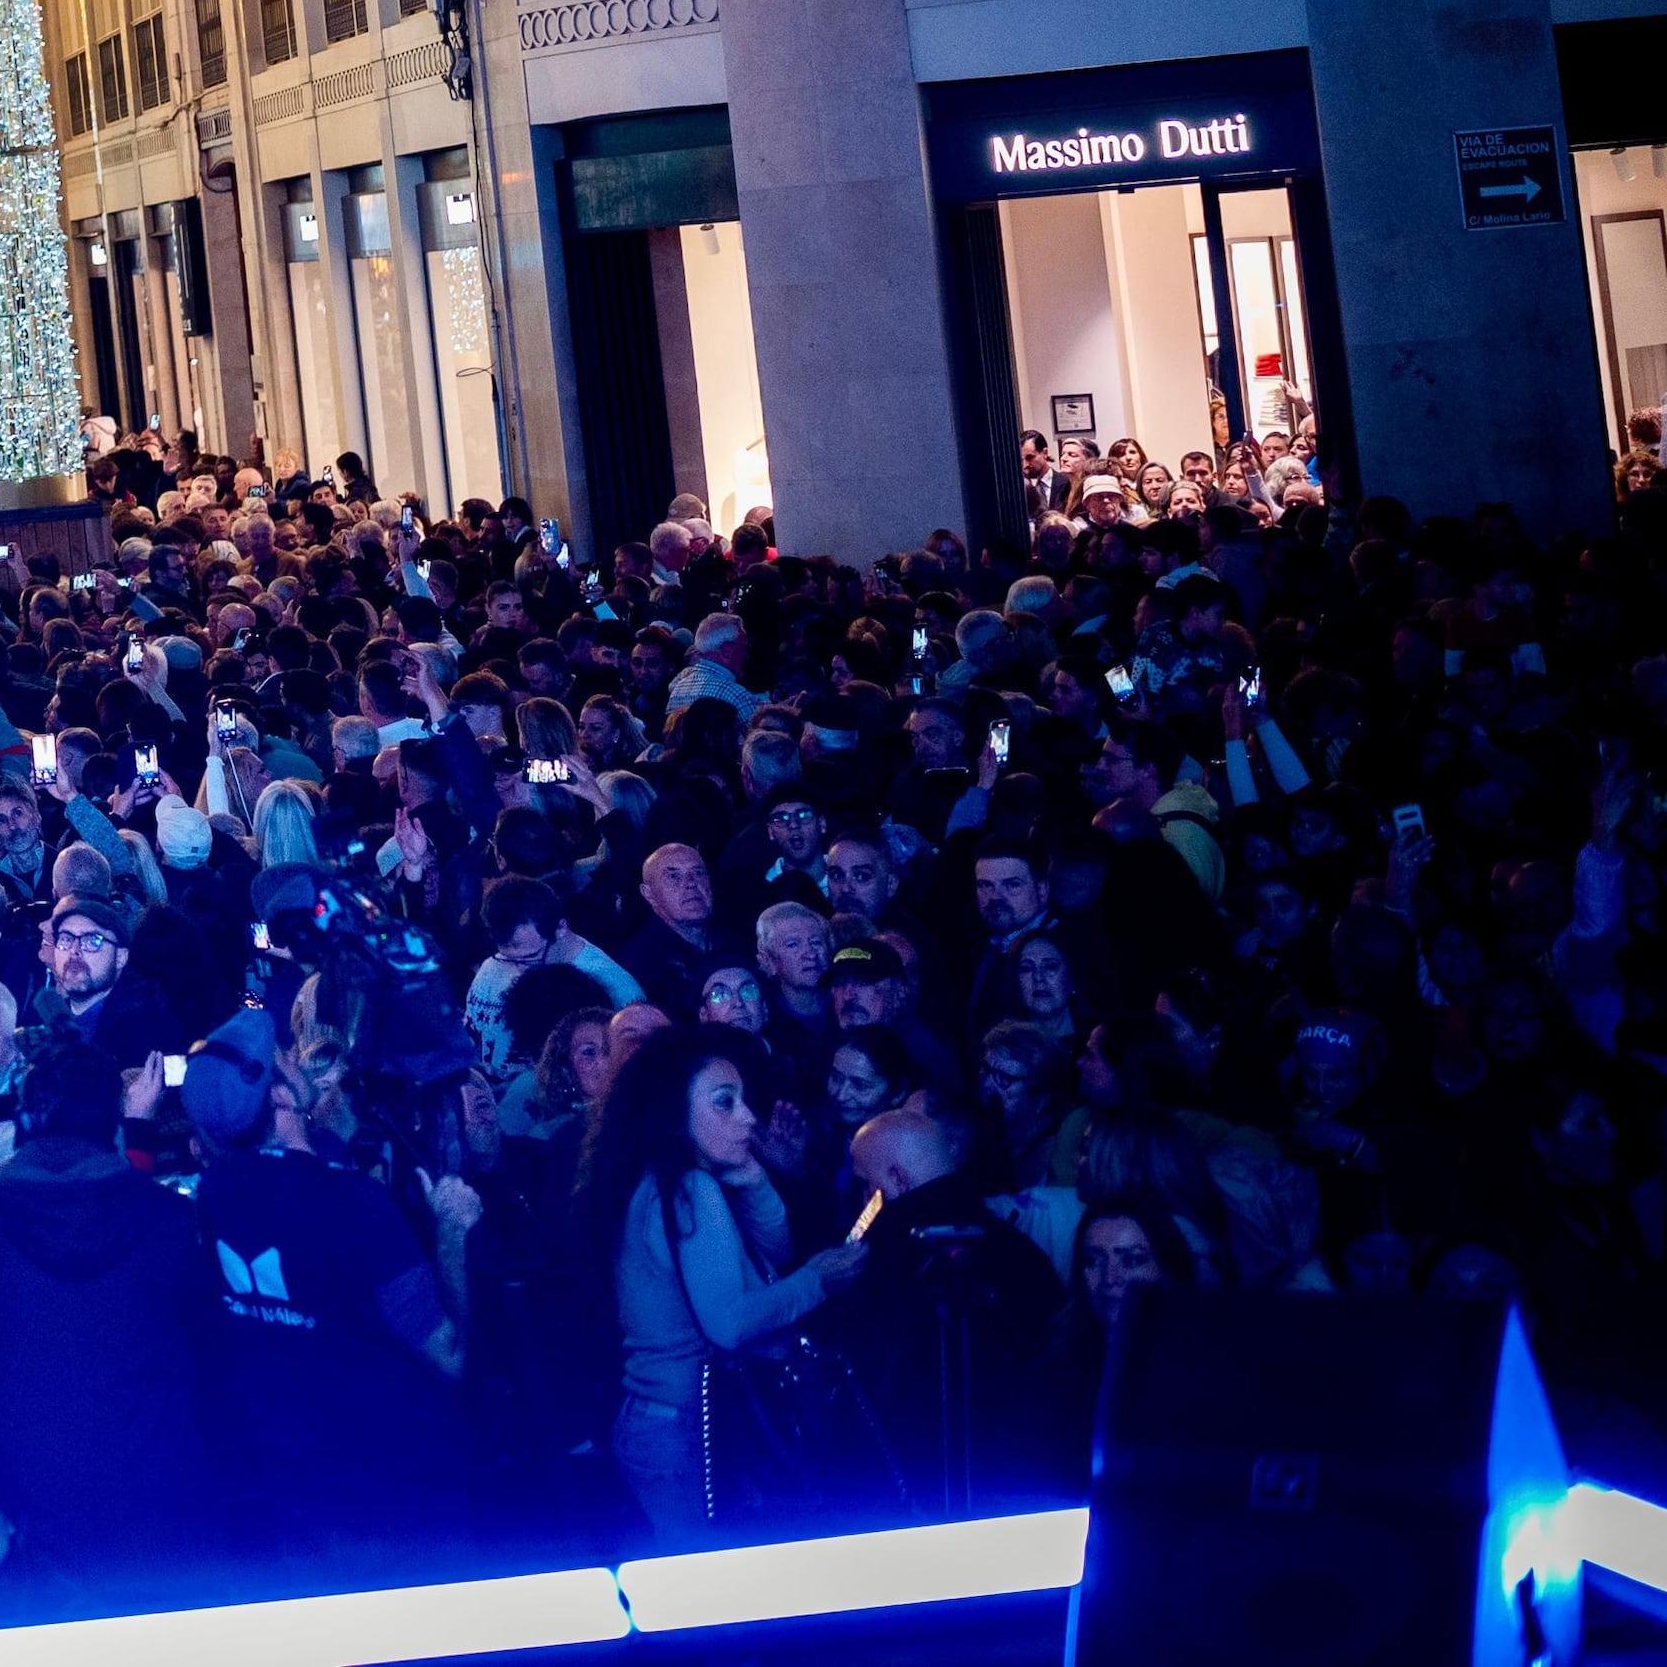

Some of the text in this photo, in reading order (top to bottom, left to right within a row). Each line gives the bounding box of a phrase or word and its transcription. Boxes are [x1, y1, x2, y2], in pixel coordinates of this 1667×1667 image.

[992, 113, 1250, 173] Massimo Dutti
[1459, 133, 1504, 147] VIA DE
[1461, 141, 1549, 159] EVACUACION
